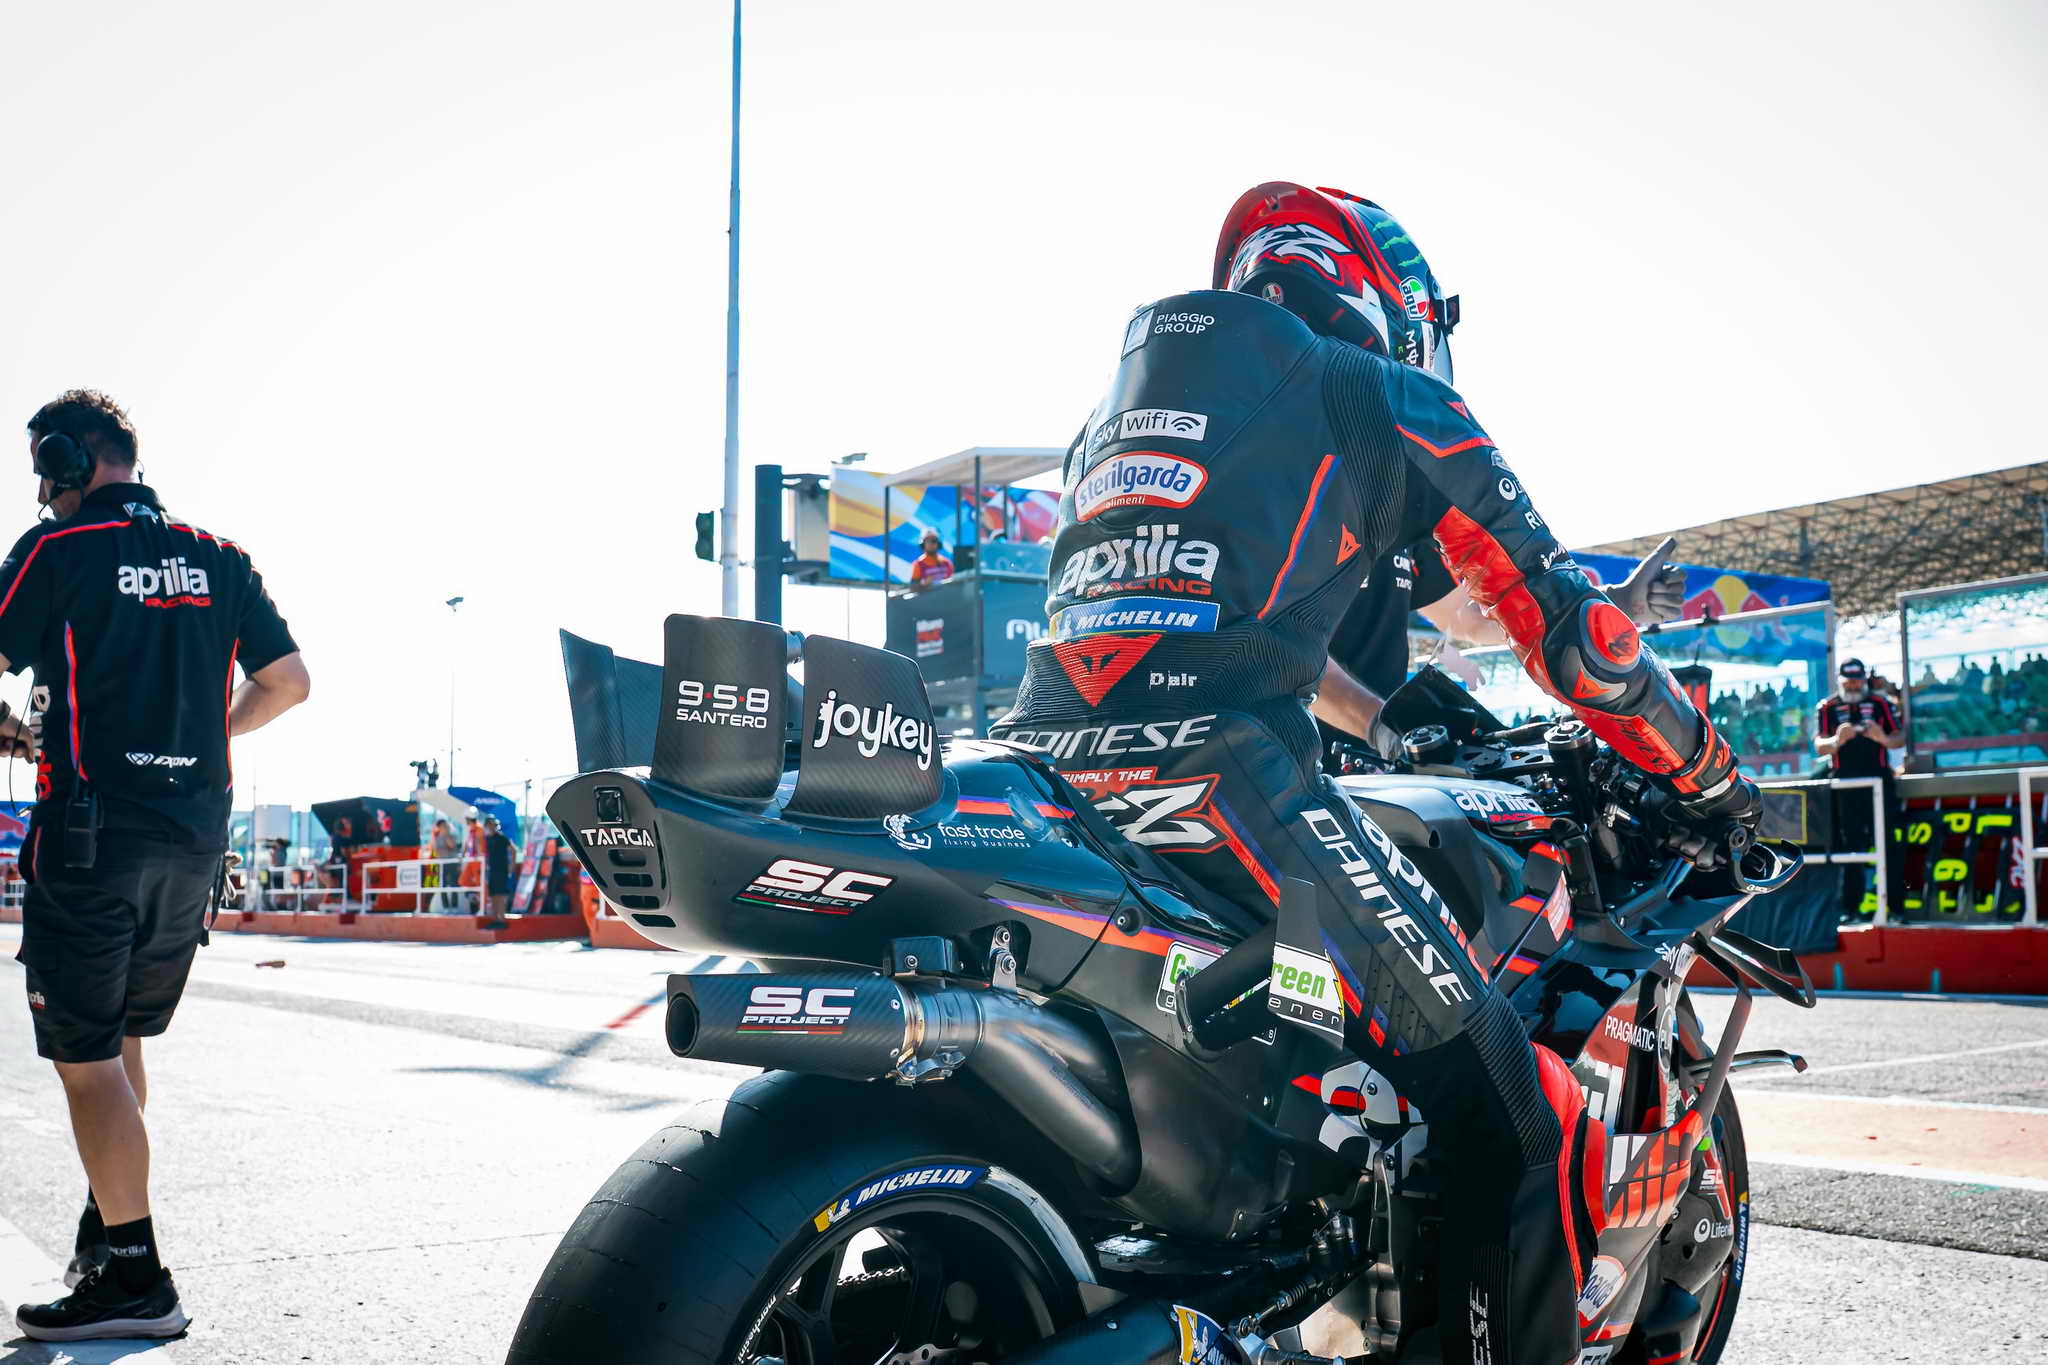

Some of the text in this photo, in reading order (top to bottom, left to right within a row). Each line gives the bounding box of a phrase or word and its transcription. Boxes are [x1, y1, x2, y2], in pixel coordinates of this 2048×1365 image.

[1154, 322, 1206, 335] GROUP
[1156, 313, 1215, 326] PIAGGIO
[1126, 411, 1168, 432] wifi
[1080, 460, 1192, 508] sterilgarda
[1103, 495, 1146, 509] alimenti
[1057, 524, 1220, 597] aprilia
[118, 556, 210, 603] aprilia
[1086, 577, 1213, 599] RACING
[1074, 610, 1199, 632] MICHELIN
[676, 708, 768, 729] SANTERO
[813, 690, 933, 771] joykey
[1118, 769, 1153, 782] THE
[1450, 788, 1545, 819] aprilia
[580, 827, 655, 848] TARGA
[937, 822, 1026, 841] fast trade
[943, 839, 1031, 848] fixing business
[753, 858, 893, 902] SC
[745, 884, 865, 907] PROJECT
[1300, 807, 1473, 1006] DAINESE
[1271, 962, 1327, 1000] reen
[745, 986, 855, 1017] SC
[741, 1015, 849, 1025] PROJECT
[1604, 1015, 1656, 1051] PRAGMATIC
[855, 1168, 973, 1207] MICHELIN
[1735, 1215, 1747, 1281] MICHELIN
